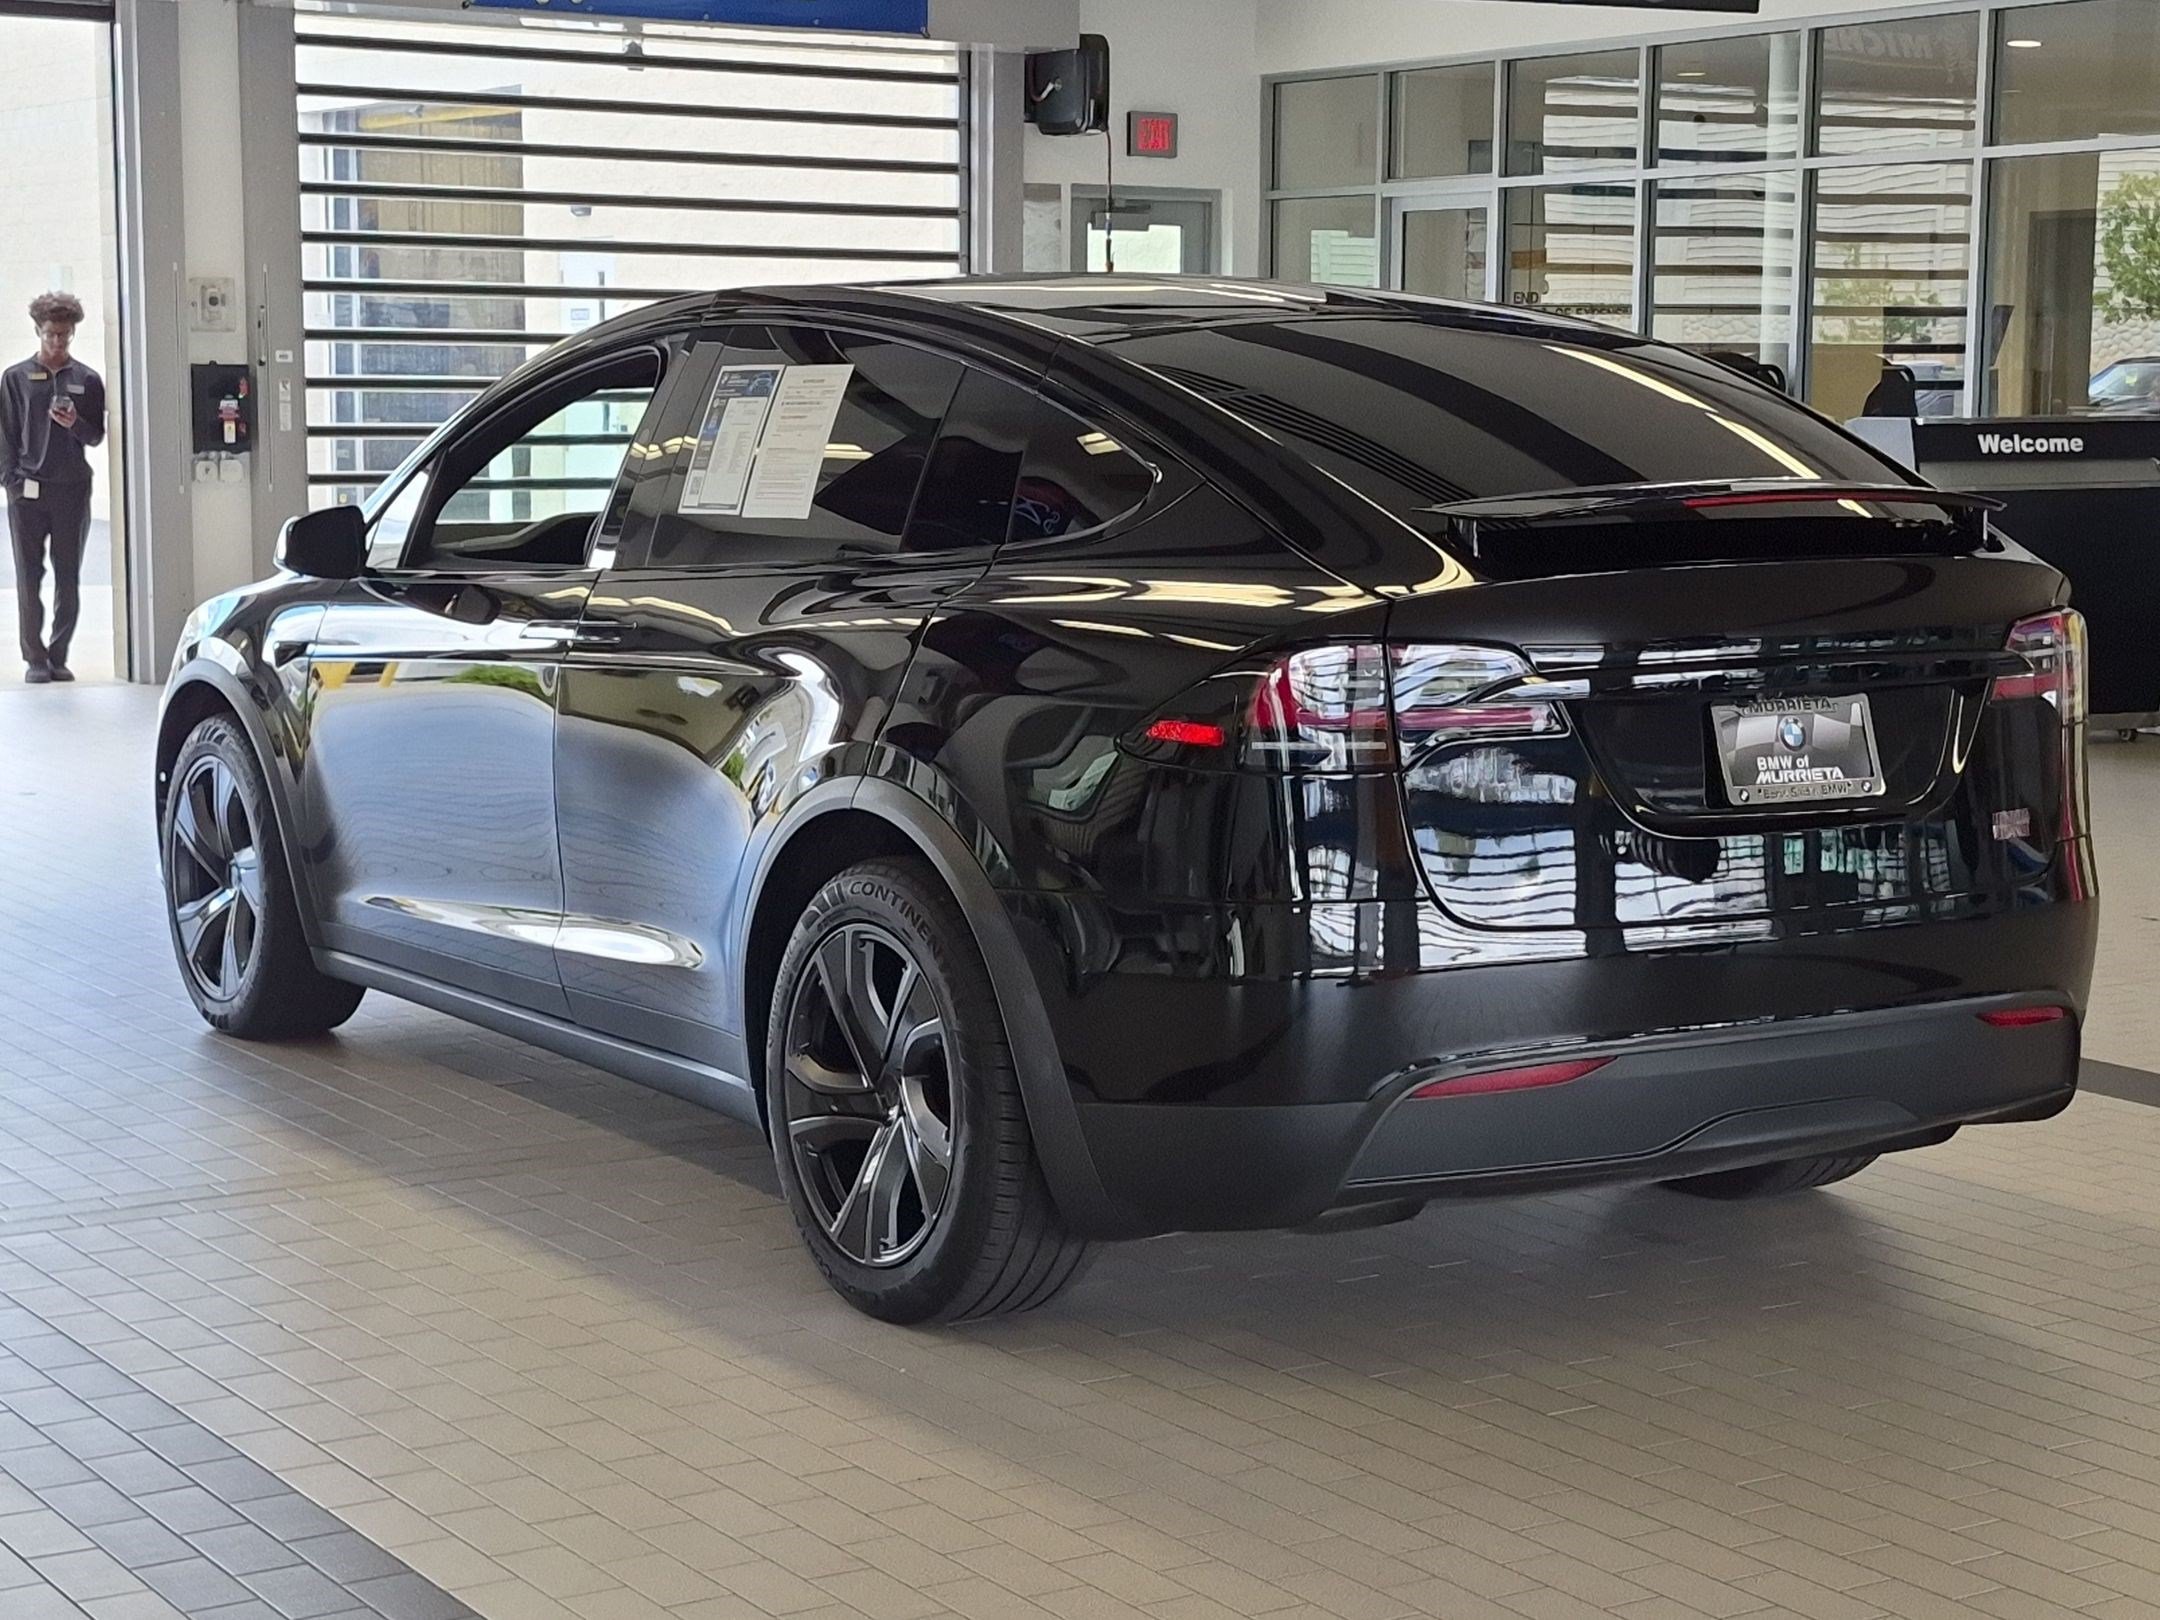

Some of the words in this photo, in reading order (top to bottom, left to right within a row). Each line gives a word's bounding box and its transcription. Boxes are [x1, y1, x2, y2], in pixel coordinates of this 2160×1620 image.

[1977, 434, 2084, 454] Welcome
[1748, 696, 1833, 714] MURRIETA
[1756, 756, 1793, 771] BMW
[1796, 755, 1810, 768] of
[1755, 766, 1845, 785] MURRIETA
